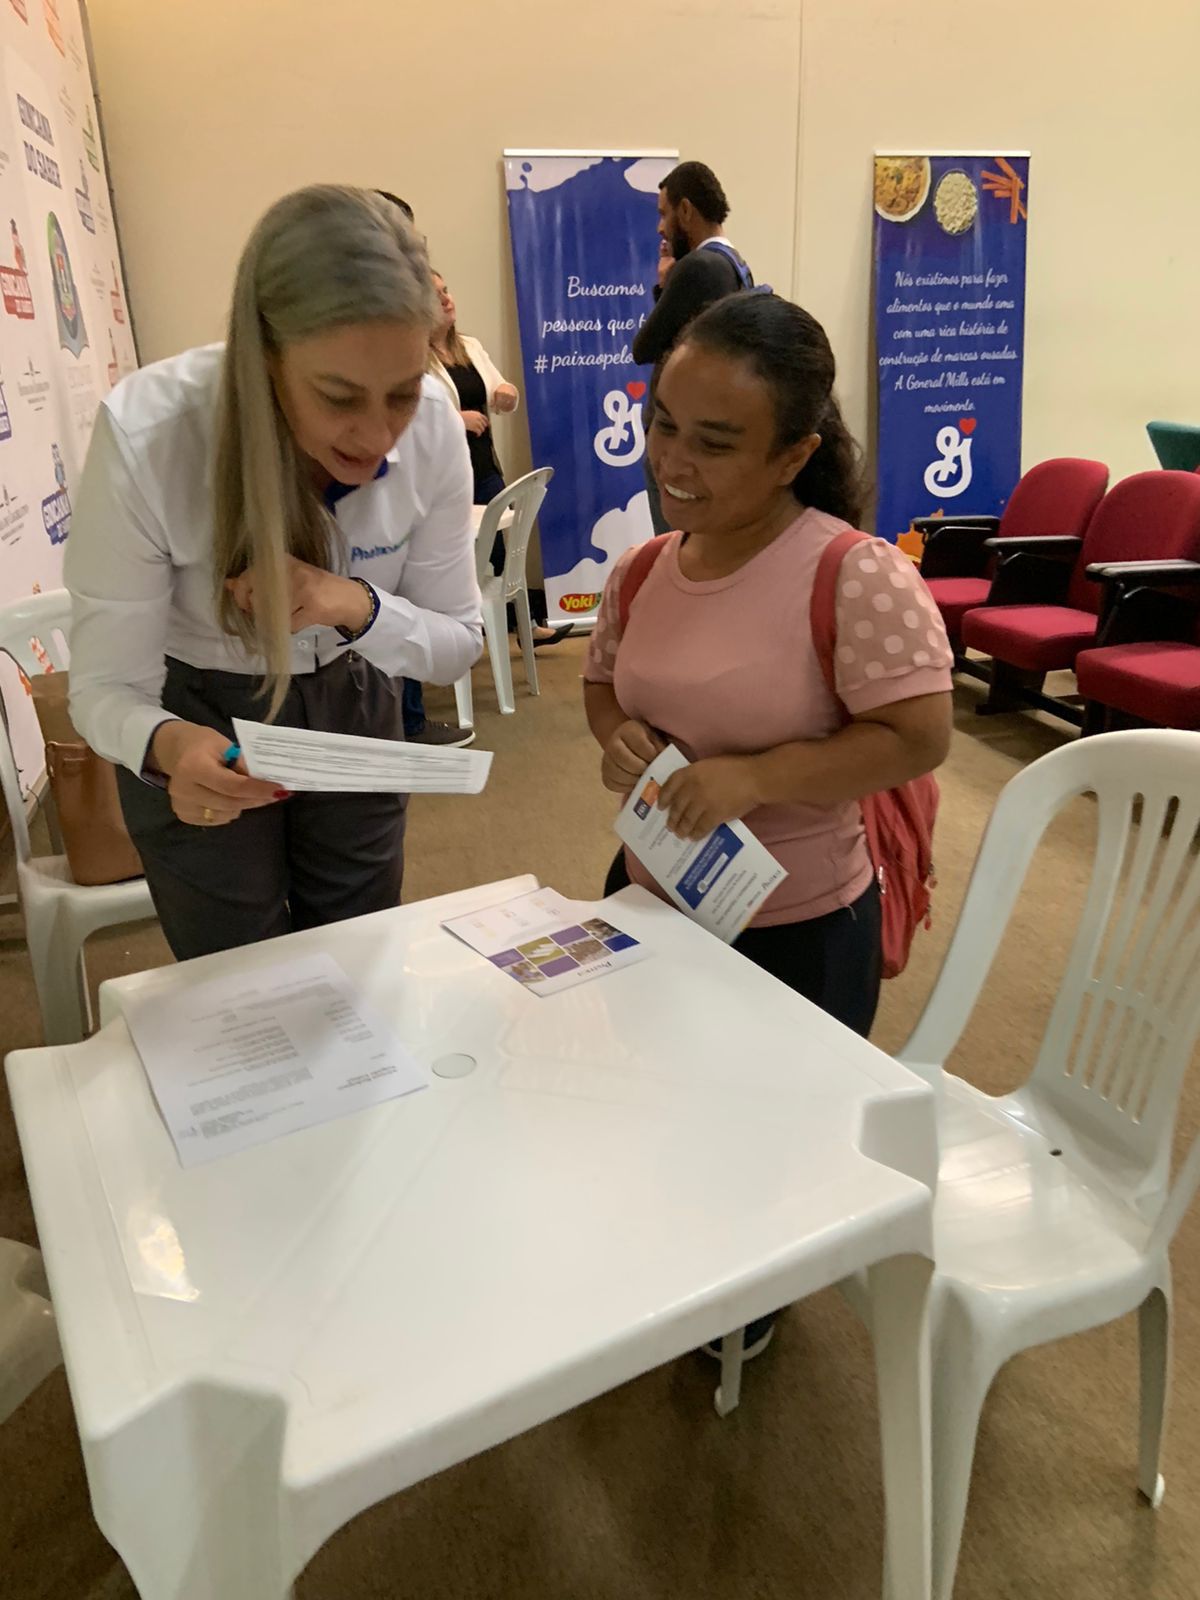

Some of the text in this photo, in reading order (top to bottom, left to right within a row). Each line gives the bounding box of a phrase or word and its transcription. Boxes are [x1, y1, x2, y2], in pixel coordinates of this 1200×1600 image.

[567, 275, 646, 298] Buscamos
[894, 268, 1008, 288] Nós existimos para fazer
[886, 294, 1015, 315] alimentos que o mundo ama
[542, 318, 603, 339] pessoas
[607, 319, 635, 337] que
[893, 319, 1009, 340] com uma rica história de
[534, 344, 634, 373] #paixaopelo
[879, 352, 929, 366] construção
[930, 347, 942, 363] de
[944, 351, 978, 362] marcas
[894, 371, 1006, 391] A General Mills está em
